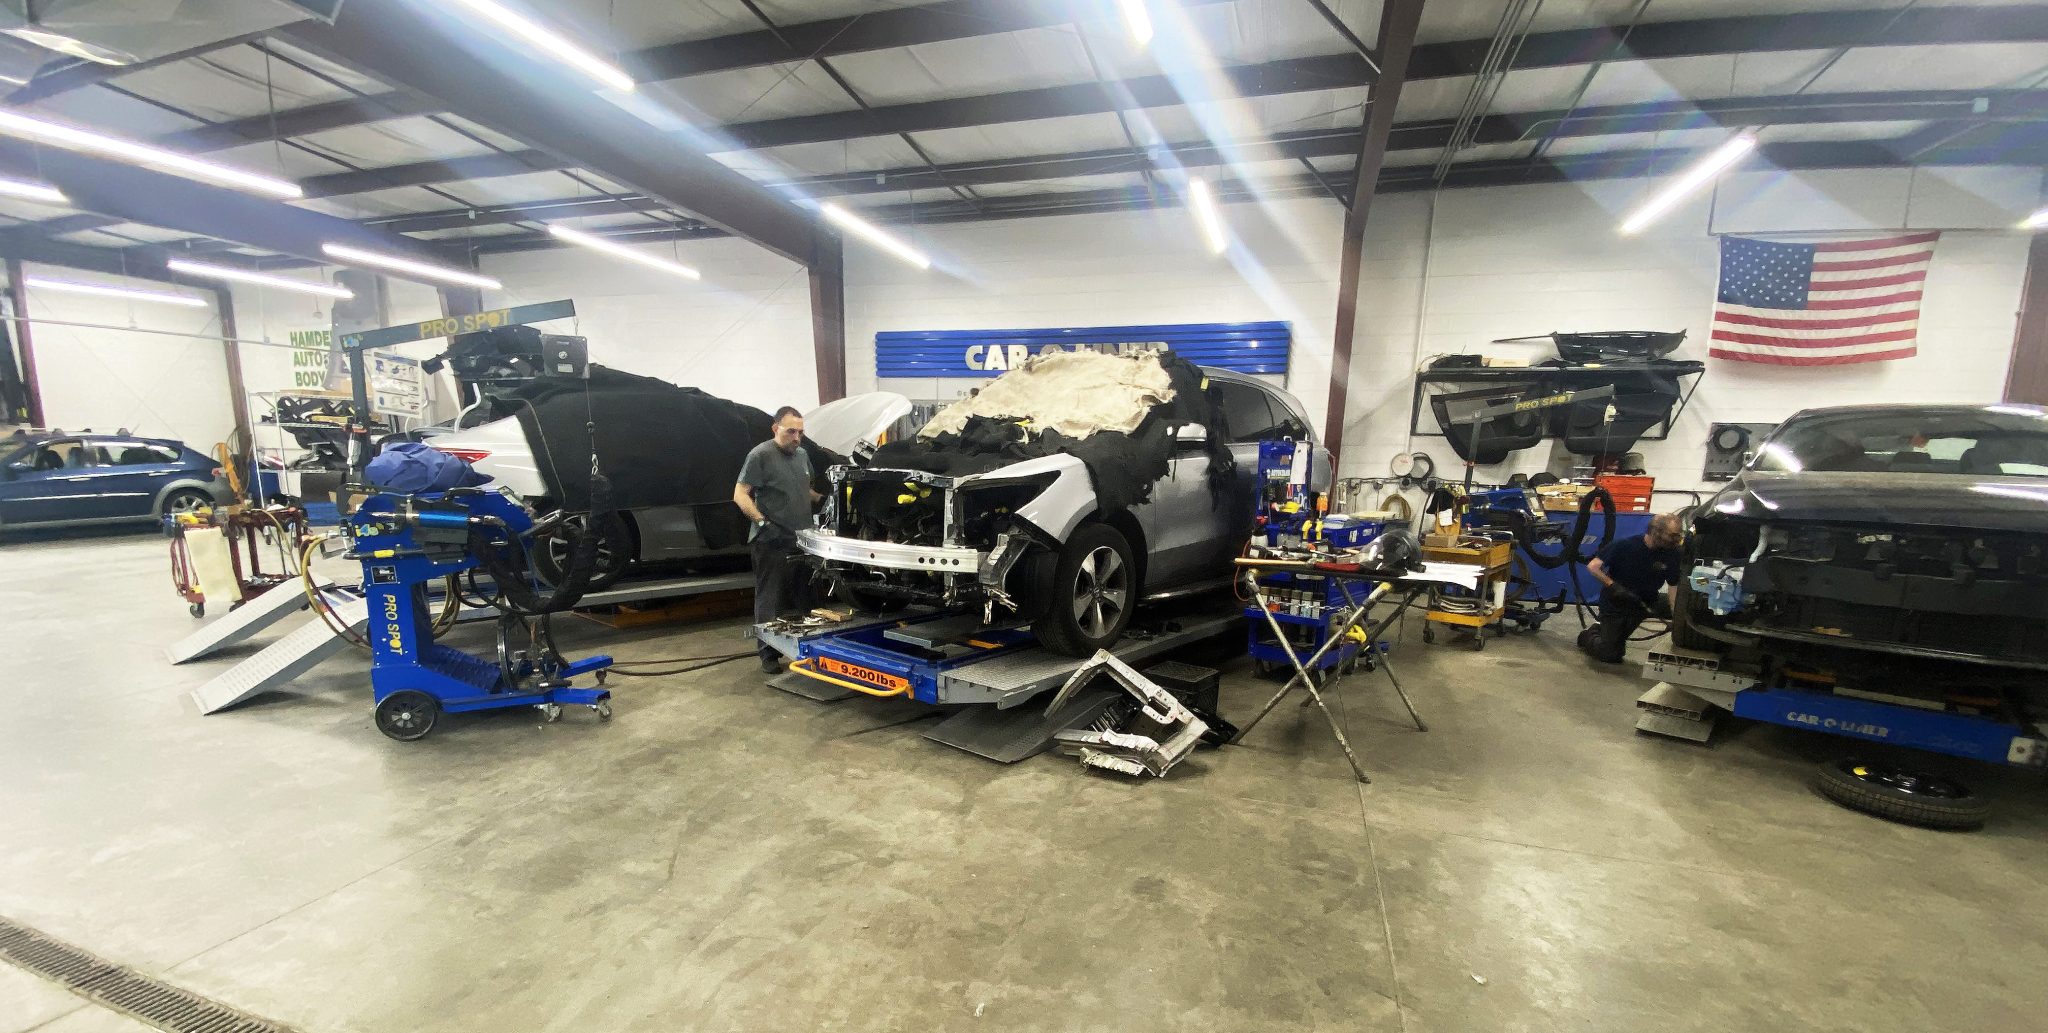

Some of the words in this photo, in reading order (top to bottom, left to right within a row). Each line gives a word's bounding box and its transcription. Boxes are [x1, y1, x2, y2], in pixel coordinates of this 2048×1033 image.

[420, 317, 459, 339] PRO
[463, 308, 510, 331] SPOT
[289, 330, 332, 347] HAMDE
[294, 350, 322, 368] AUTO
[295, 371, 325, 387] BODY
[1515, 401, 1539, 412] PRO
[1541, 394, 1574, 407] SPOT
[382, 594, 398, 621] PRO
[387, 623, 403, 656] SPOT
